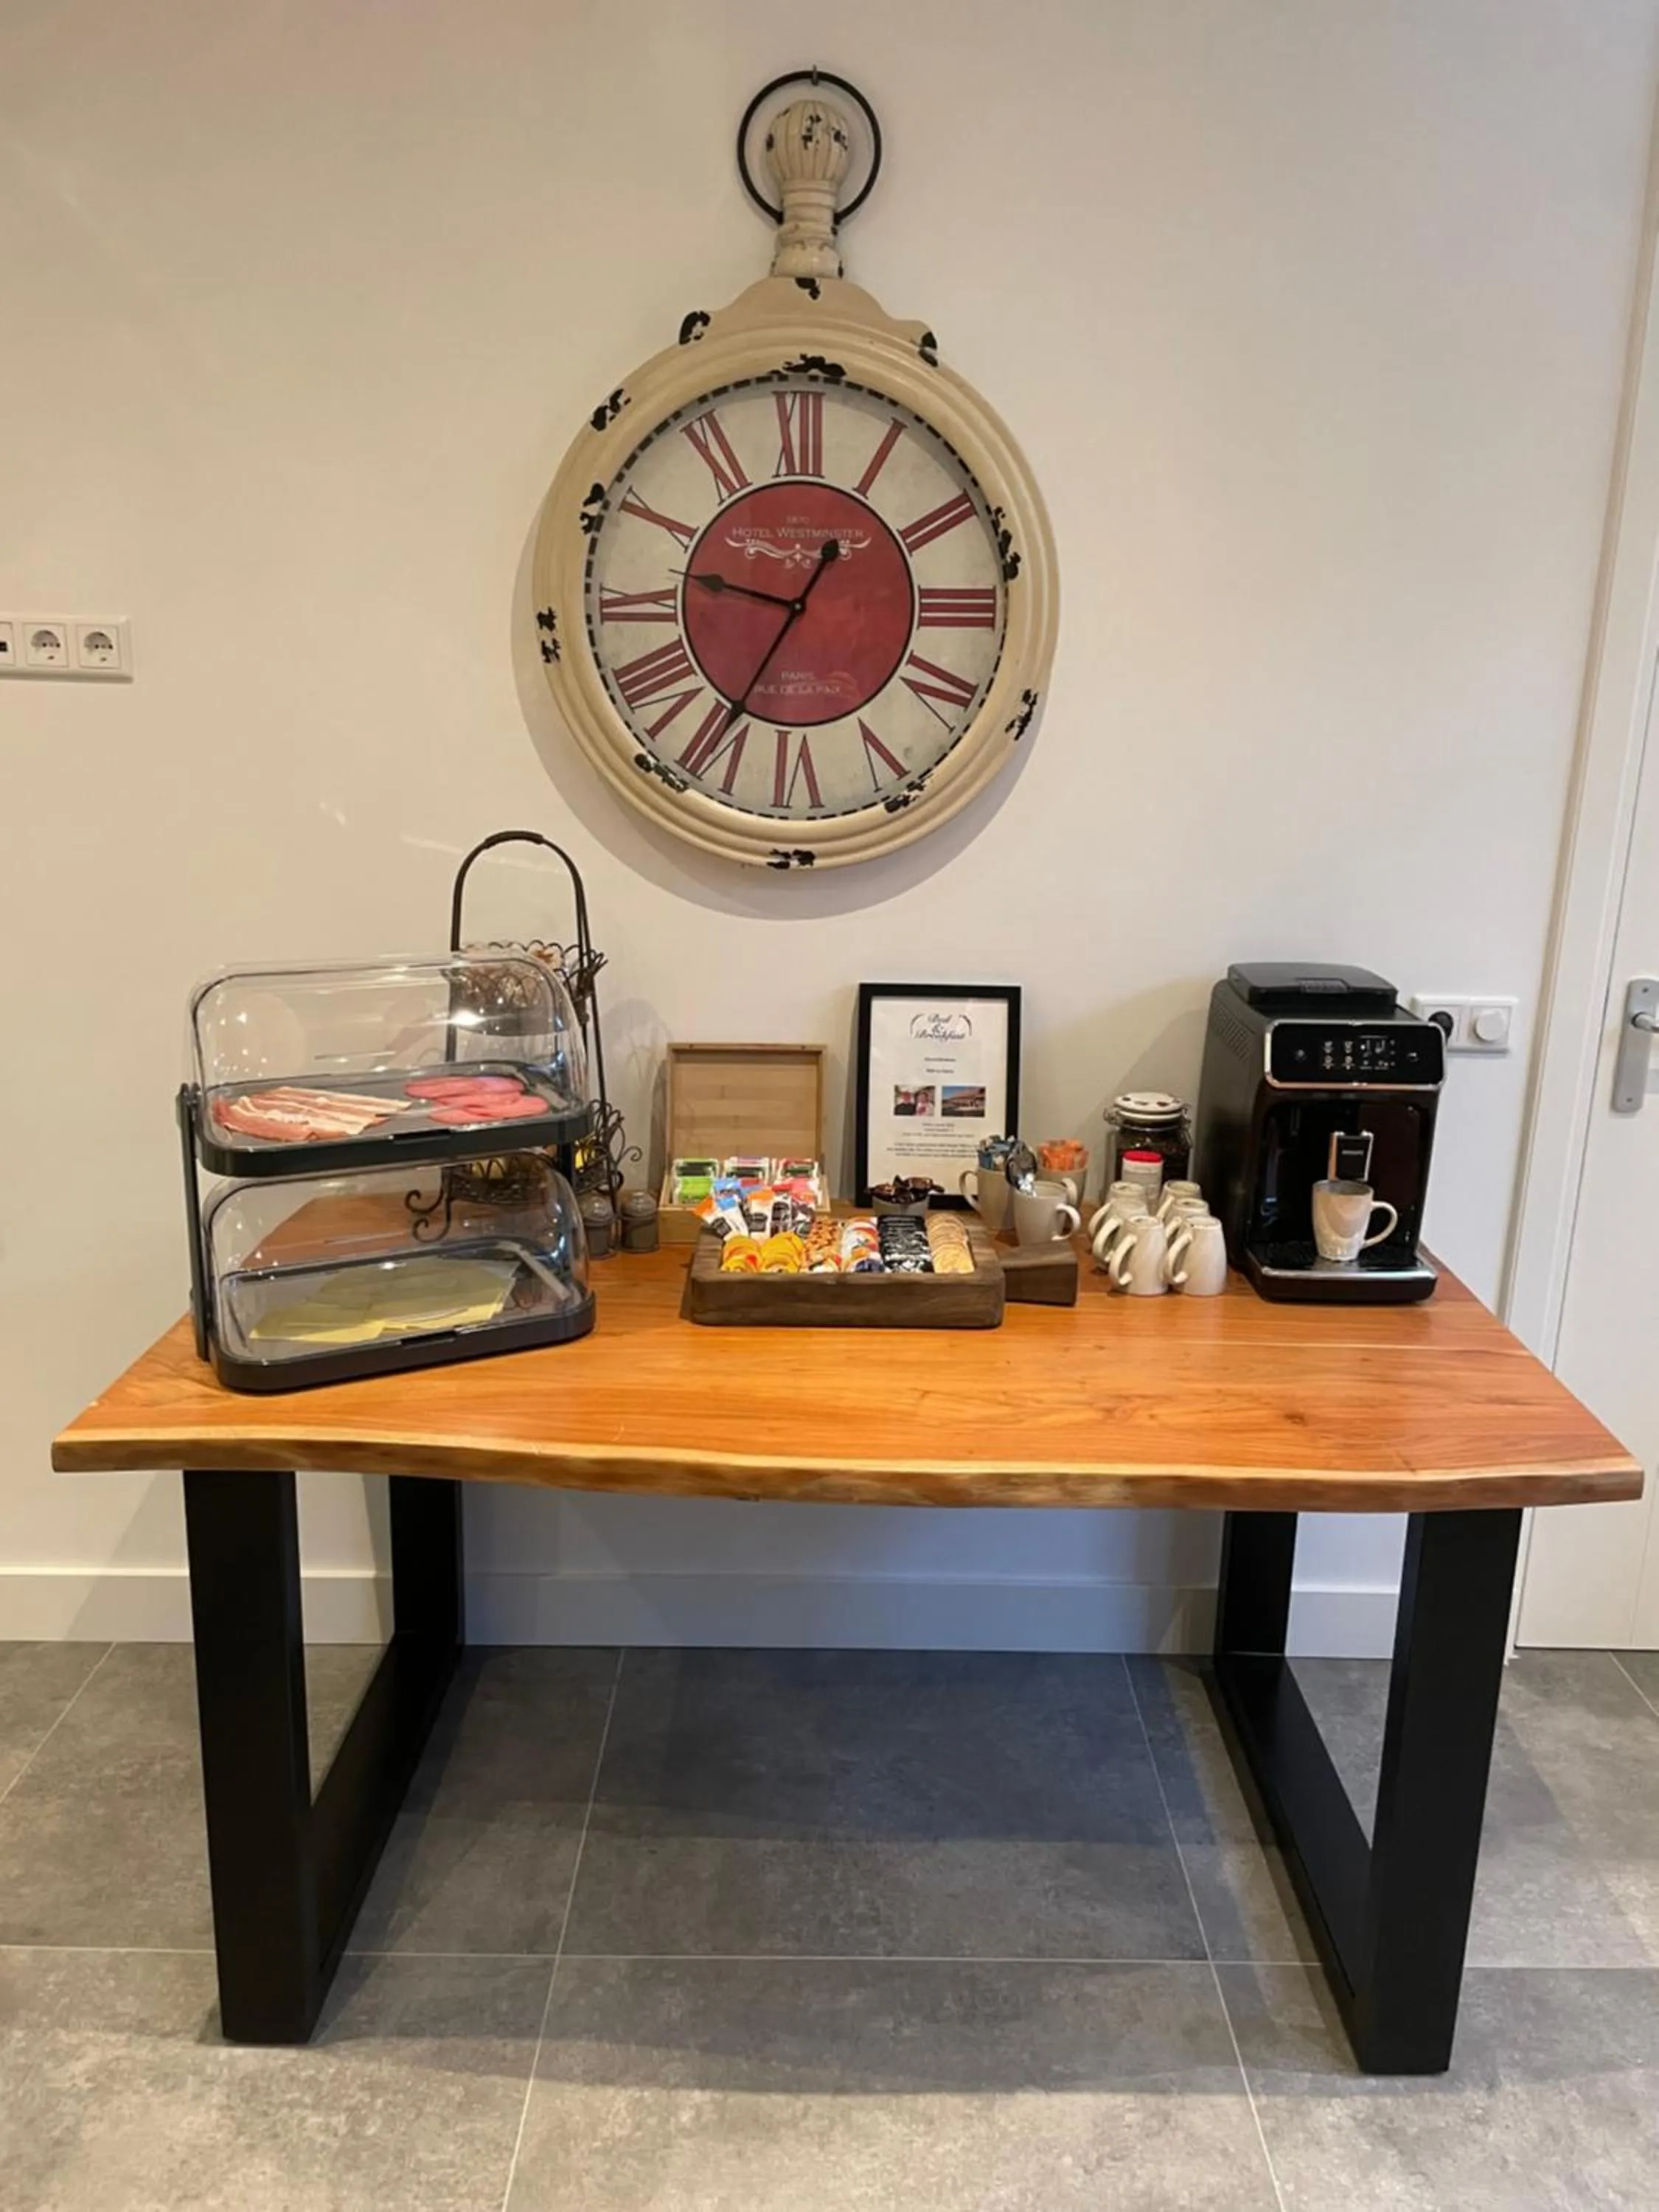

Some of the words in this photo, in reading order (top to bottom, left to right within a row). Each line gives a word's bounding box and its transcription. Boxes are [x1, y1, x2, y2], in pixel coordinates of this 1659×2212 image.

[680, 408, 753, 506] XI
[771, 390, 826, 478] XII
[852, 417, 908, 499] I
[618, 485, 700, 553] X
[897, 488, 979, 556] II
[599, 582, 678, 625] IX
[917, 585, 995, 630] III
[612, 634, 704, 742] VIII
[769, 729, 825, 808] VI
